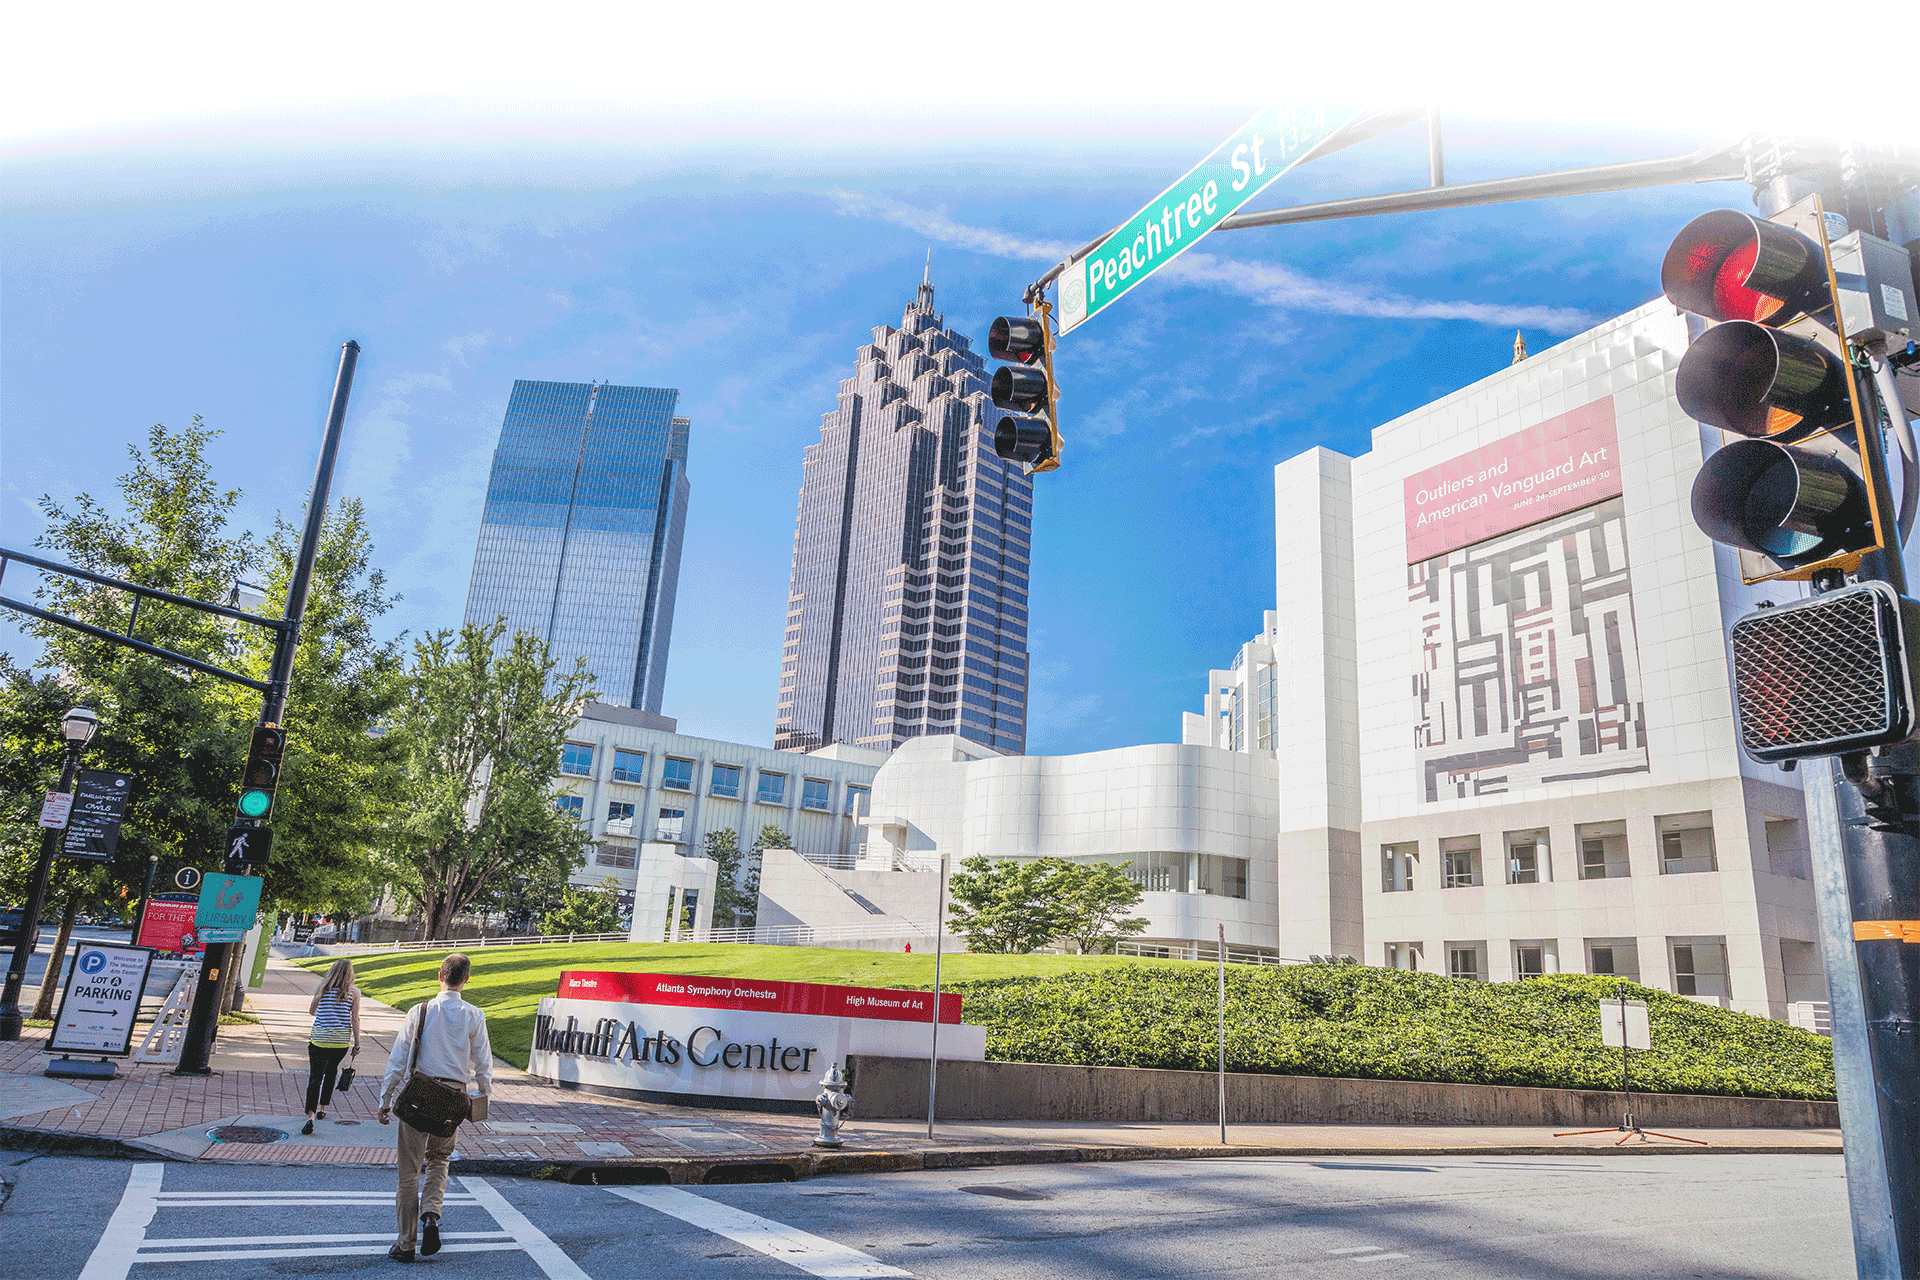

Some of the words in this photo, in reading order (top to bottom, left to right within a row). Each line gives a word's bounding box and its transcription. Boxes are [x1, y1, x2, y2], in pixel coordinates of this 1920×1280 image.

[1090, 180, 1218, 303] Peachtree
[1231, 132, 1267, 192] St
[1416, 474, 1474, 505] Outliers
[1479, 457, 1508, 482] and
[1416, 492, 1488, 527] American
[1492, 456, 1574, 499] Vanguard
[1579, 447, 1608, 469] Art
[1513, 499, 1534, 511] JUNE
[1599, 470, 1610, 480] 30
[85, 803, 112, 811] OWLS
[147, 912, 165, 920] FOR
[168, 914, 186, 922] THE
[205, 912, 247, 924] LIBRARY
[87, 956, 100, 970] P
[91, 976, 108, 984] LOT
[112, 977, 121, 986] A
[74, 986, 132, 1001] PARKING
[656, 983, 685, 994] Atlanta
[687, 984, 732, 998] Symphony
[734, 987, 777, 999] Orchestra
[846, 995, 865, 1006] High
[867, 997, 900, 1008] Museum
[902, 999, 911, 1008] of
[912, 1000, 923, 1009] Art
[613, 1020, 681, 1065] Arts
[687, 1026, 817, 1073] Center
